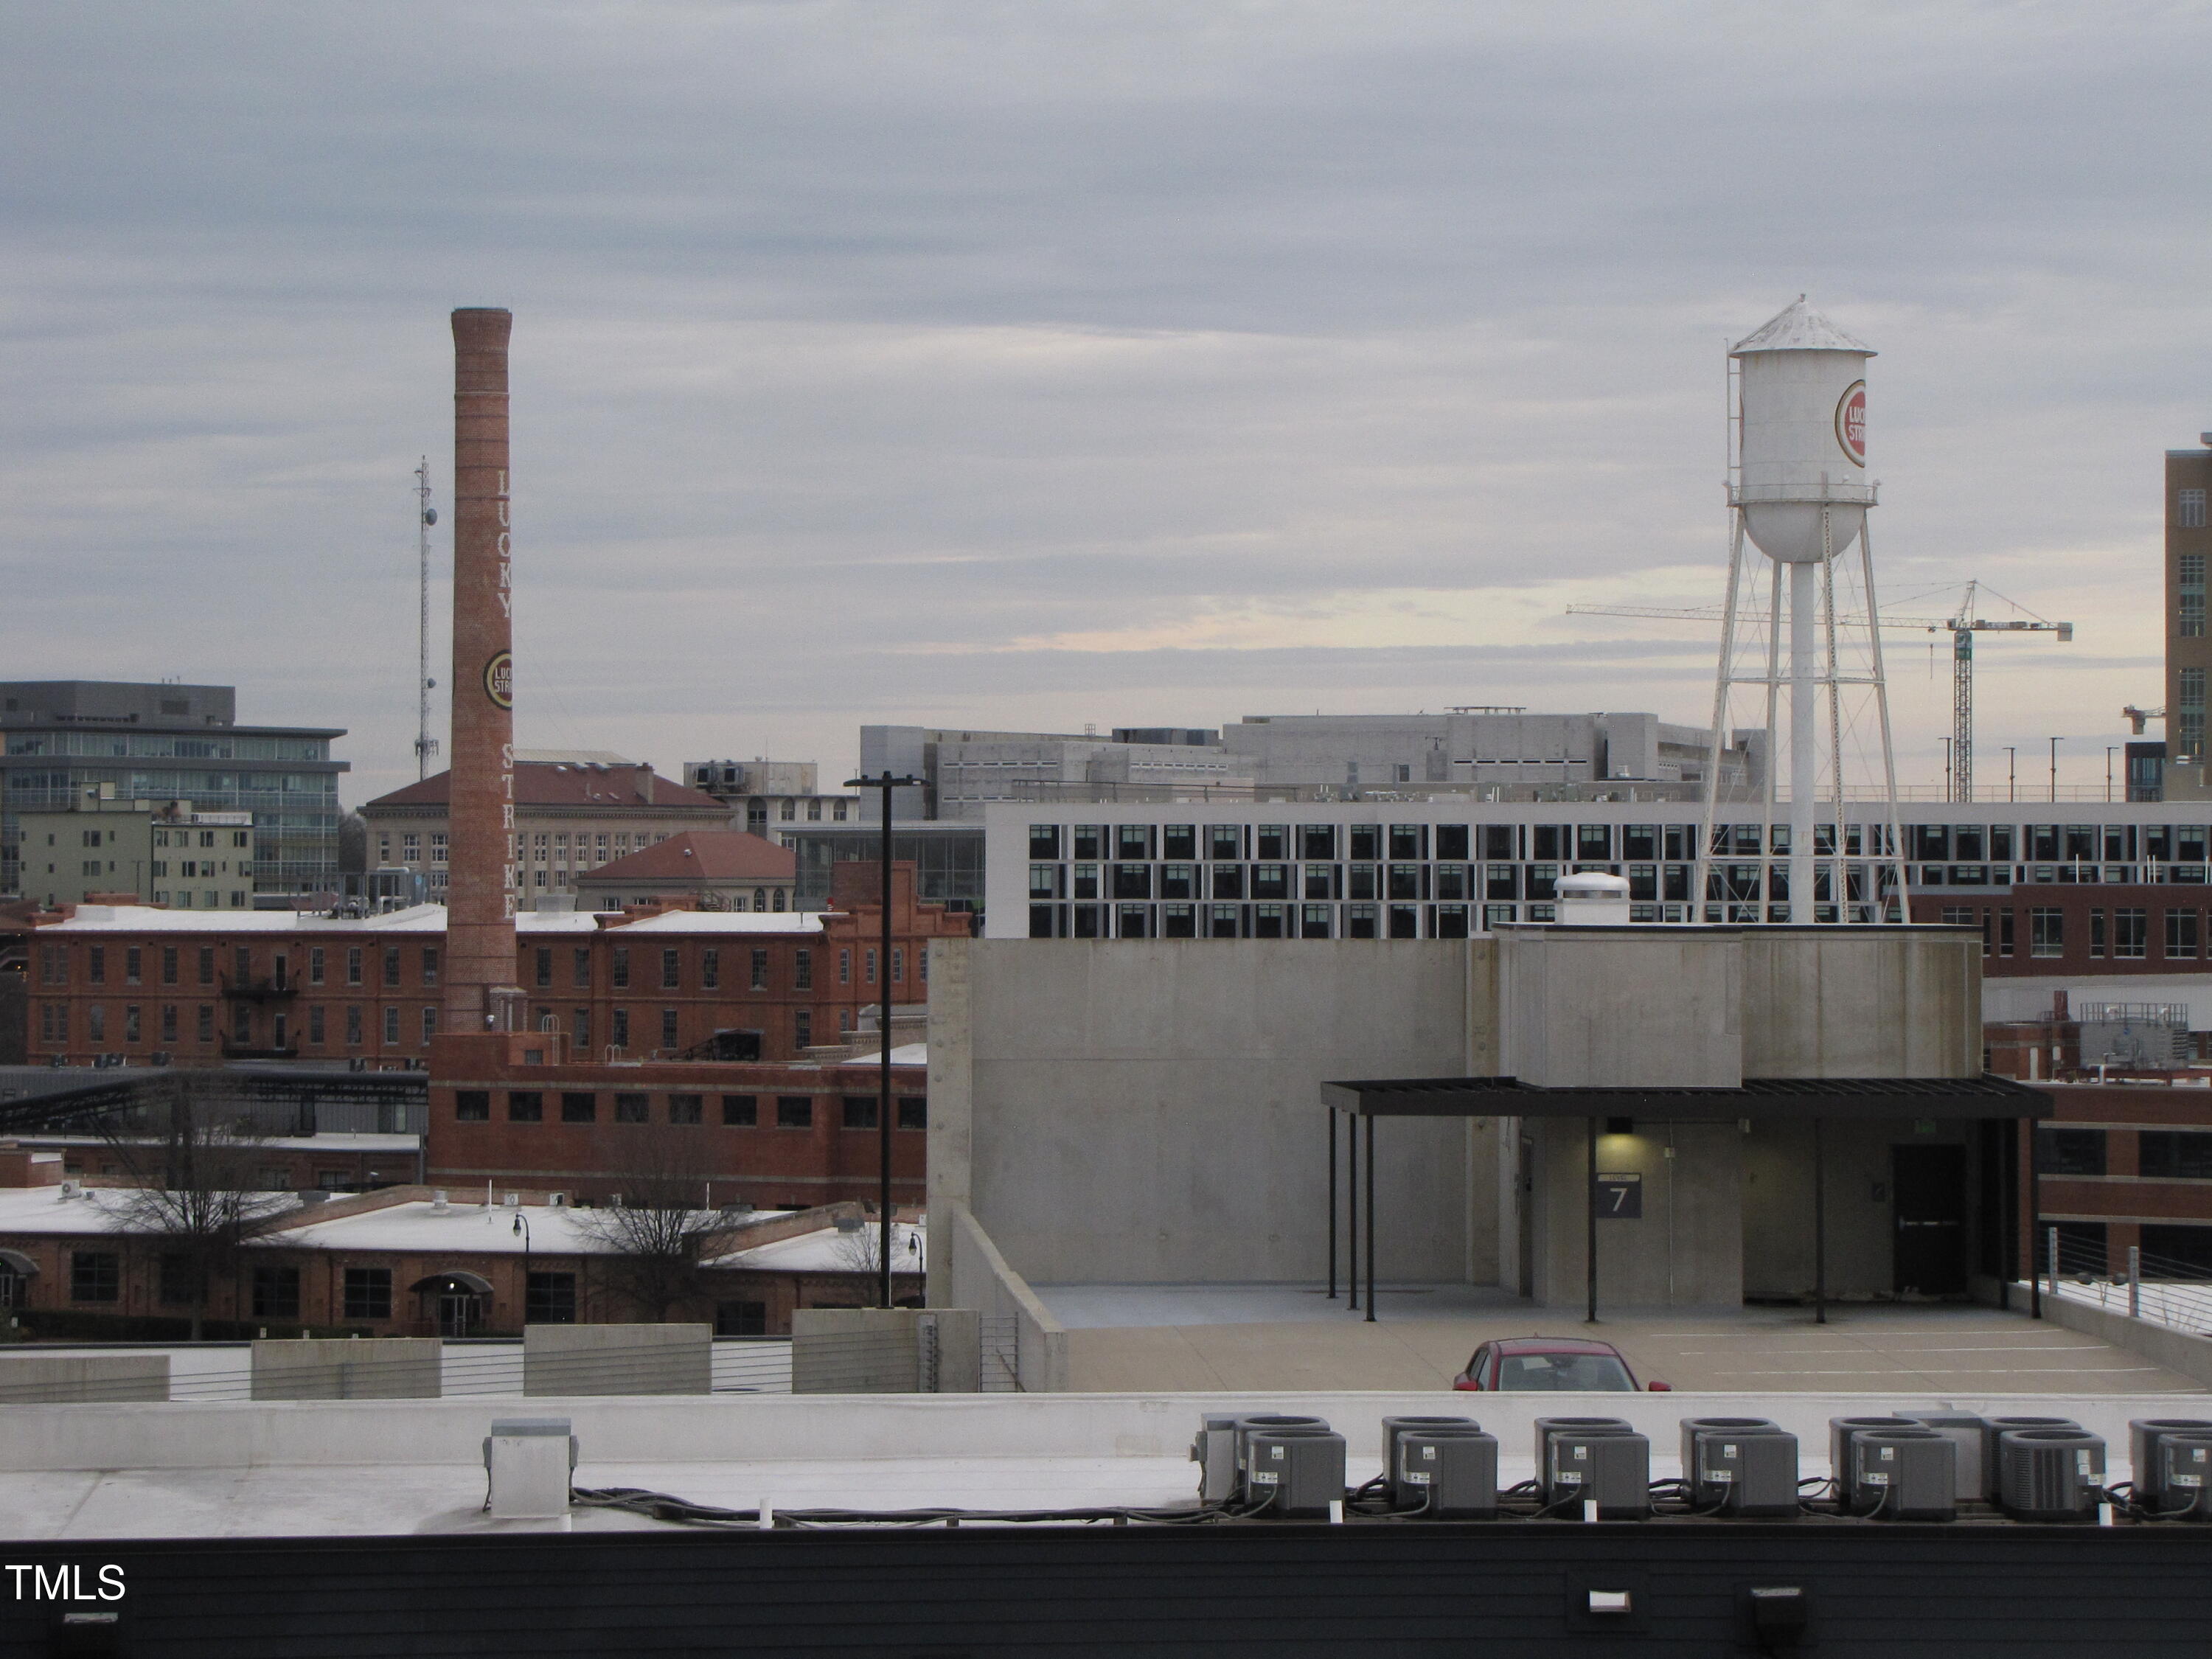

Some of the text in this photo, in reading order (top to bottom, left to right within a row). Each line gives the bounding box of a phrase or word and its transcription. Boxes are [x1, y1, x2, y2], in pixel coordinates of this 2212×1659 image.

[1848, 406, 1865, 423] LUC
[1848, 424, 1865, 442] STR
[495, 667, 512, 679] LUC
[495, 680, 512, 692] STR
[501, 743, 515, 919] STRIKE
[1610, 1187, 1628, 1212] 7
